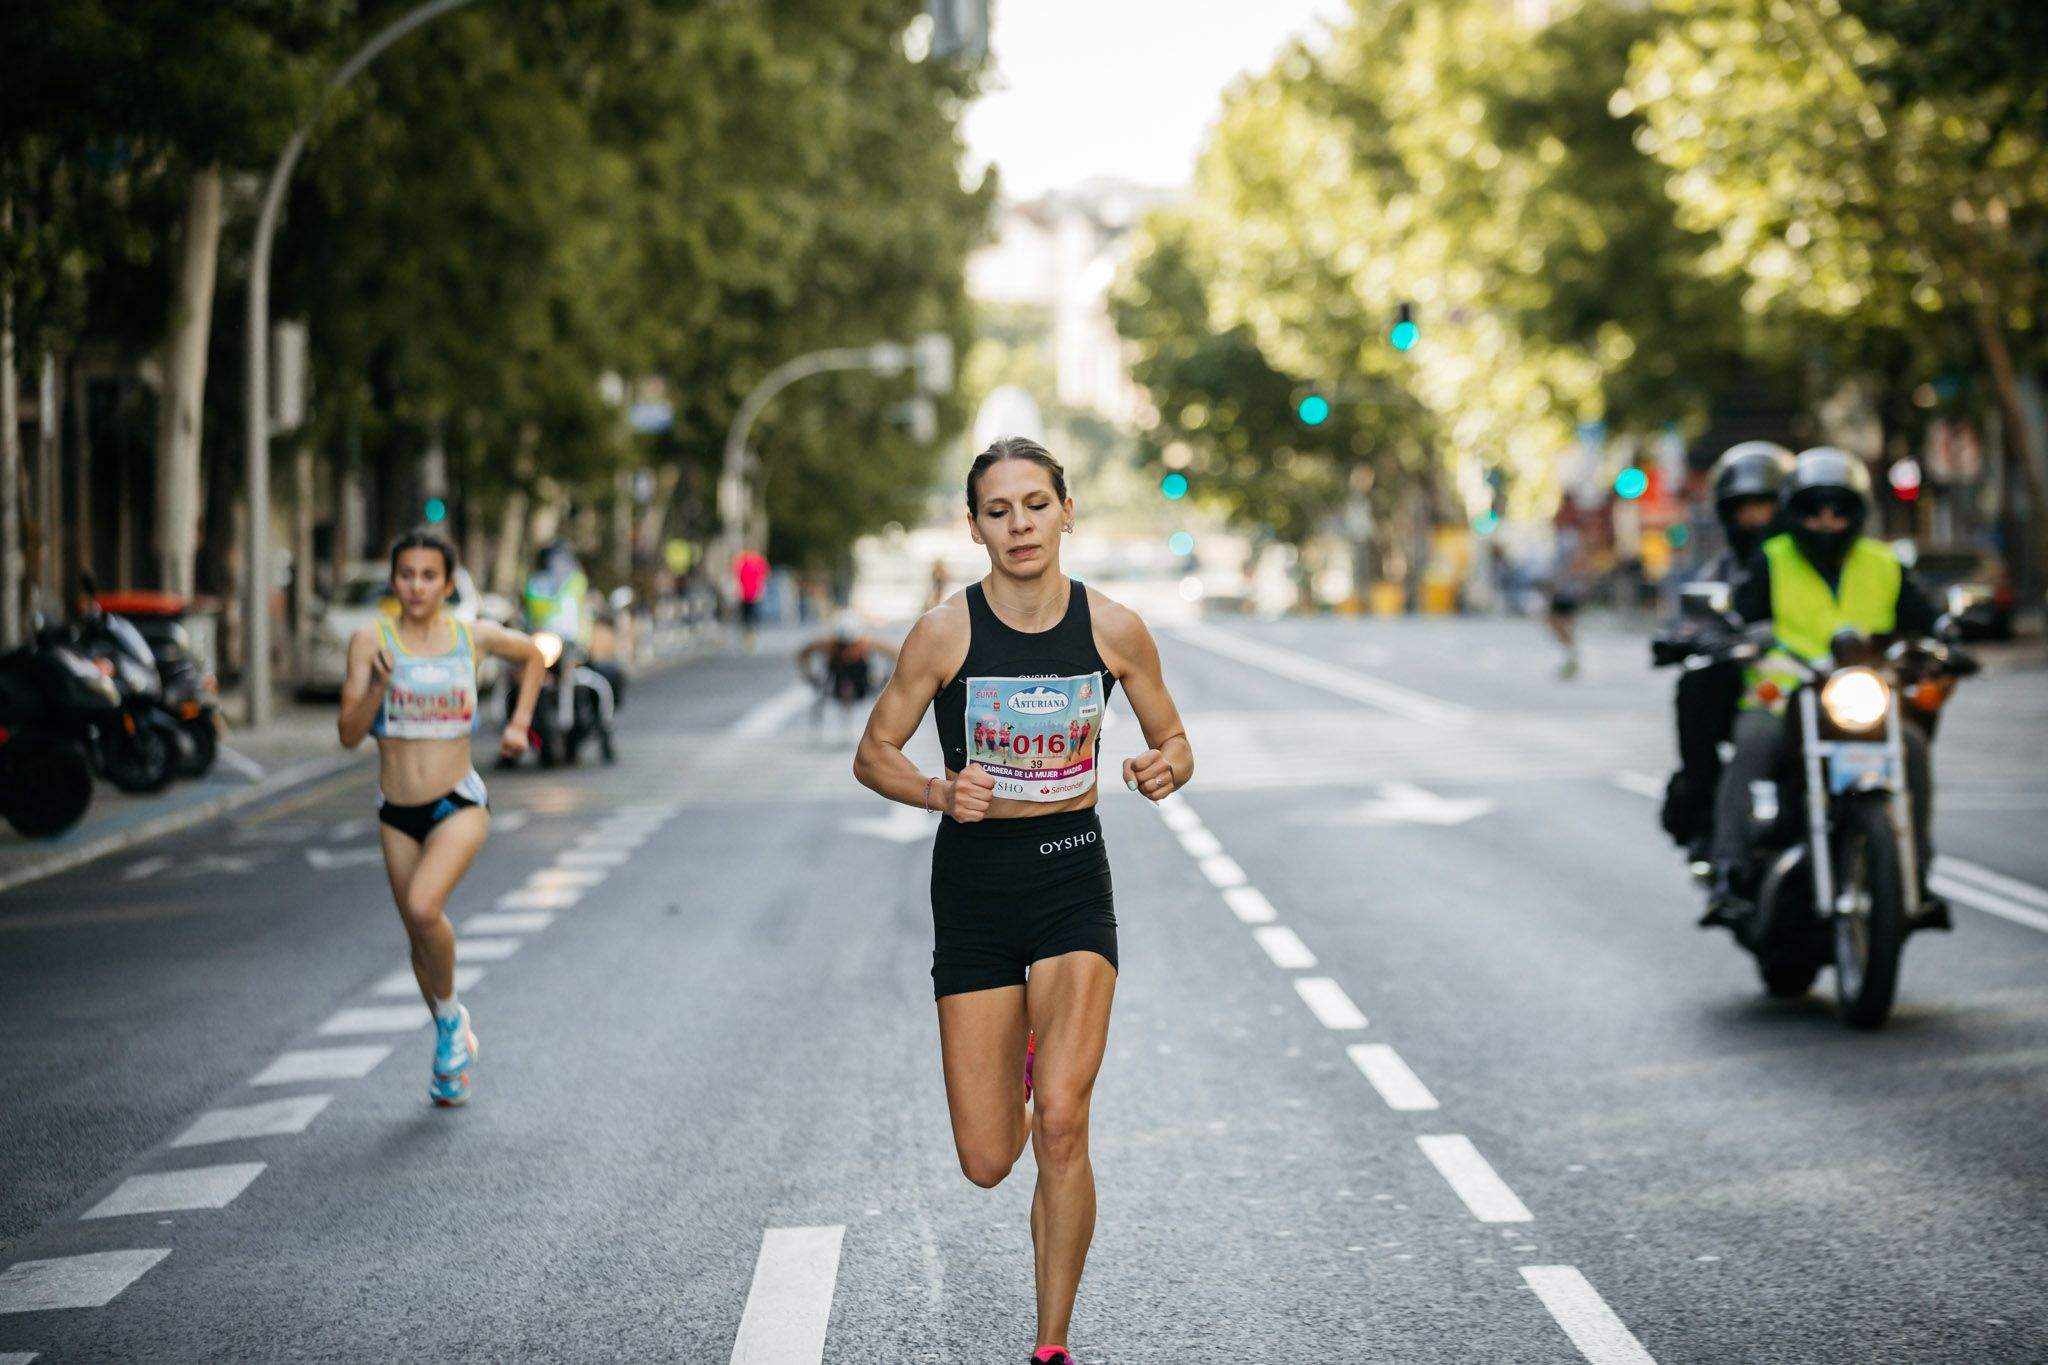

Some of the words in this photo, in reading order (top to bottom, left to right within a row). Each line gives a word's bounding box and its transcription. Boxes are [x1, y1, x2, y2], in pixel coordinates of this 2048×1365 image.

[1013, 697, 1065, 709] ASTURIANA
[1013, 734, 1066, 755] 016
[983, 764, 1013, 776] CARRERA
[1063, 765, 1082, 776] MADRID
[1030, 760, 1043, 769] 39
[995, 781, 1024, 794] SHO
[1051, 781, 1084, 794] Santander
[1039, 831, 1097, 854] OYSHO
